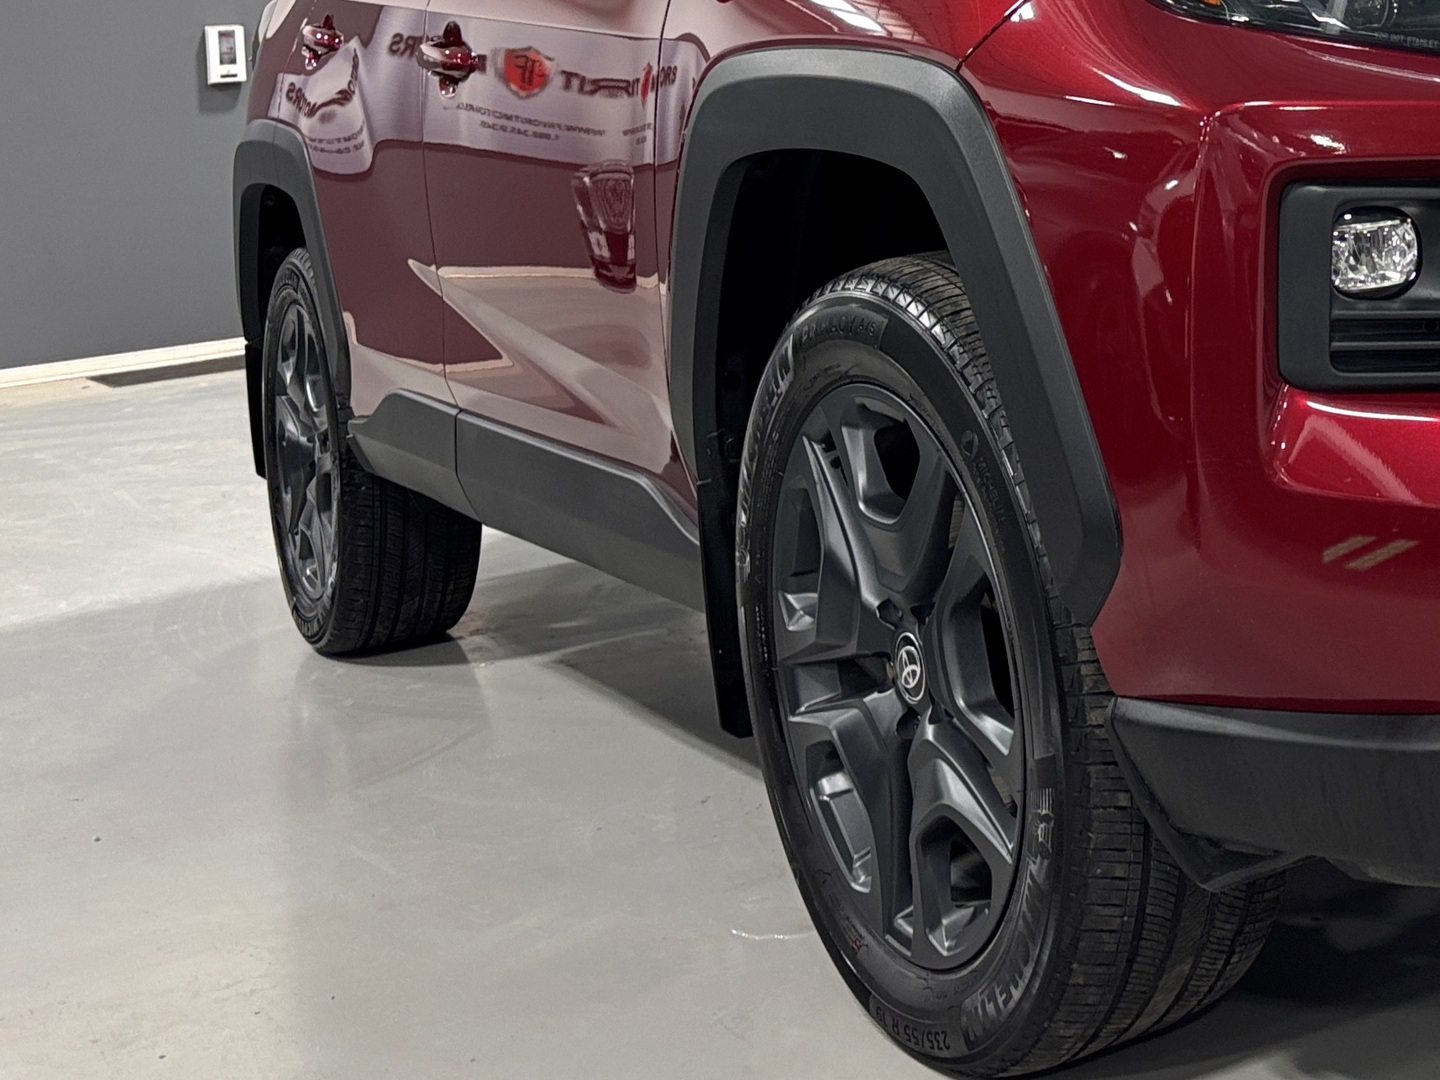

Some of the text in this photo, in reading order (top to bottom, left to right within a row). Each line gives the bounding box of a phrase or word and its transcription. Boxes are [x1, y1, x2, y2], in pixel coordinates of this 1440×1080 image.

[875, 1005, 950, 1052] 235/55 R 19
